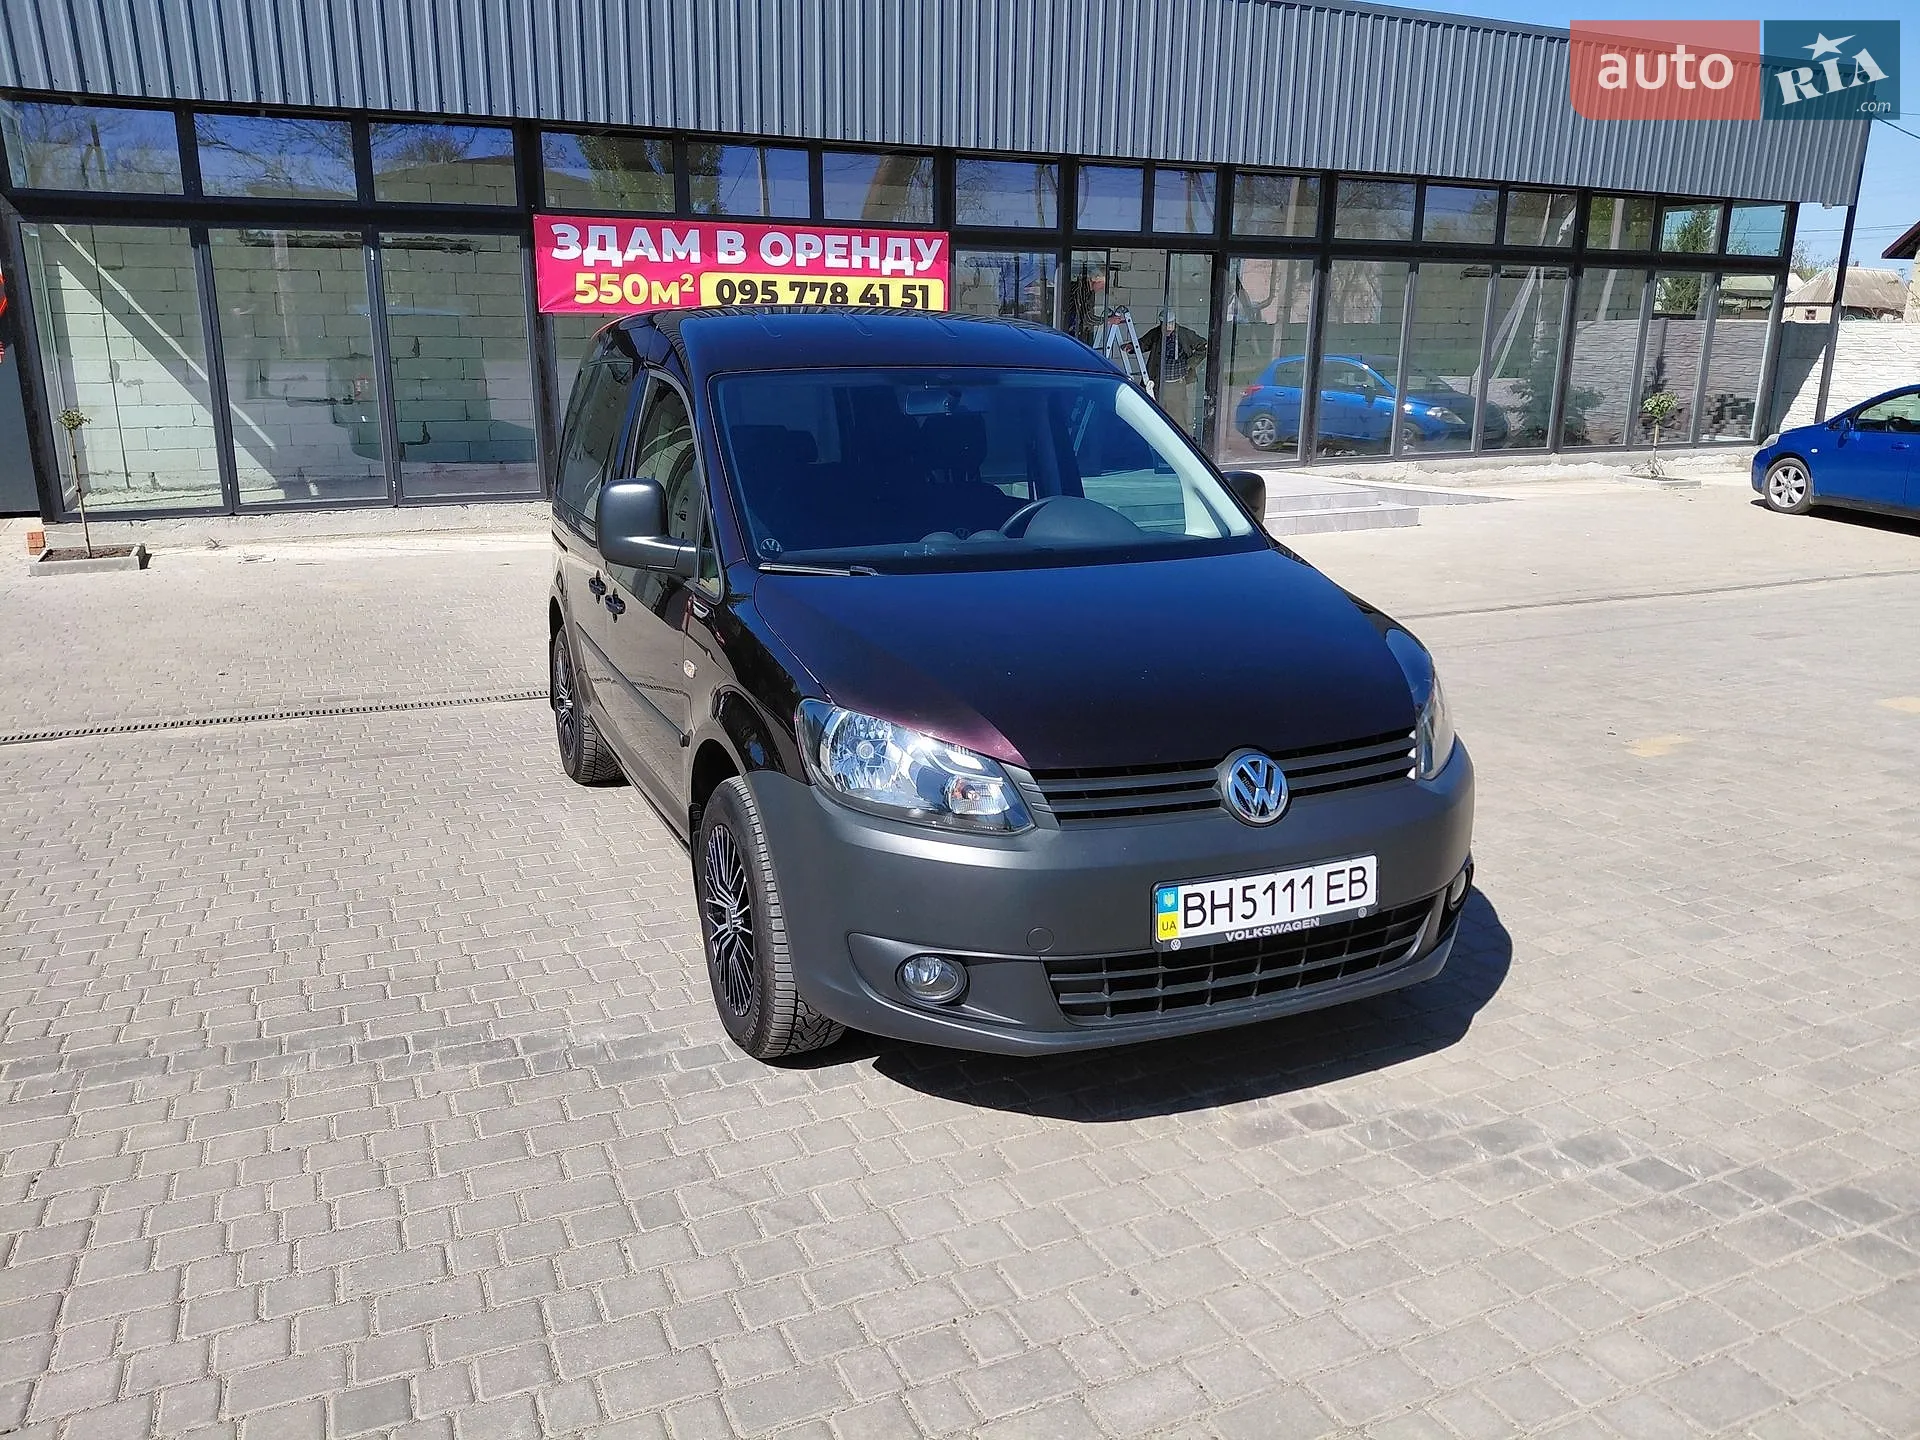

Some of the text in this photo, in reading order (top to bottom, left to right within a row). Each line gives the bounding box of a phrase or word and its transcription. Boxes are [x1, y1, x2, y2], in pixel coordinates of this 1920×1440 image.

[551, 223, 943, 276] ЗДАМ В ОРЕНДУ
[716, 279, 930, 309] 095 778 41 51
[1161, 921, 1177, 931] UA
[1225, 917, 1320, 941] VOLKSWAGEN
